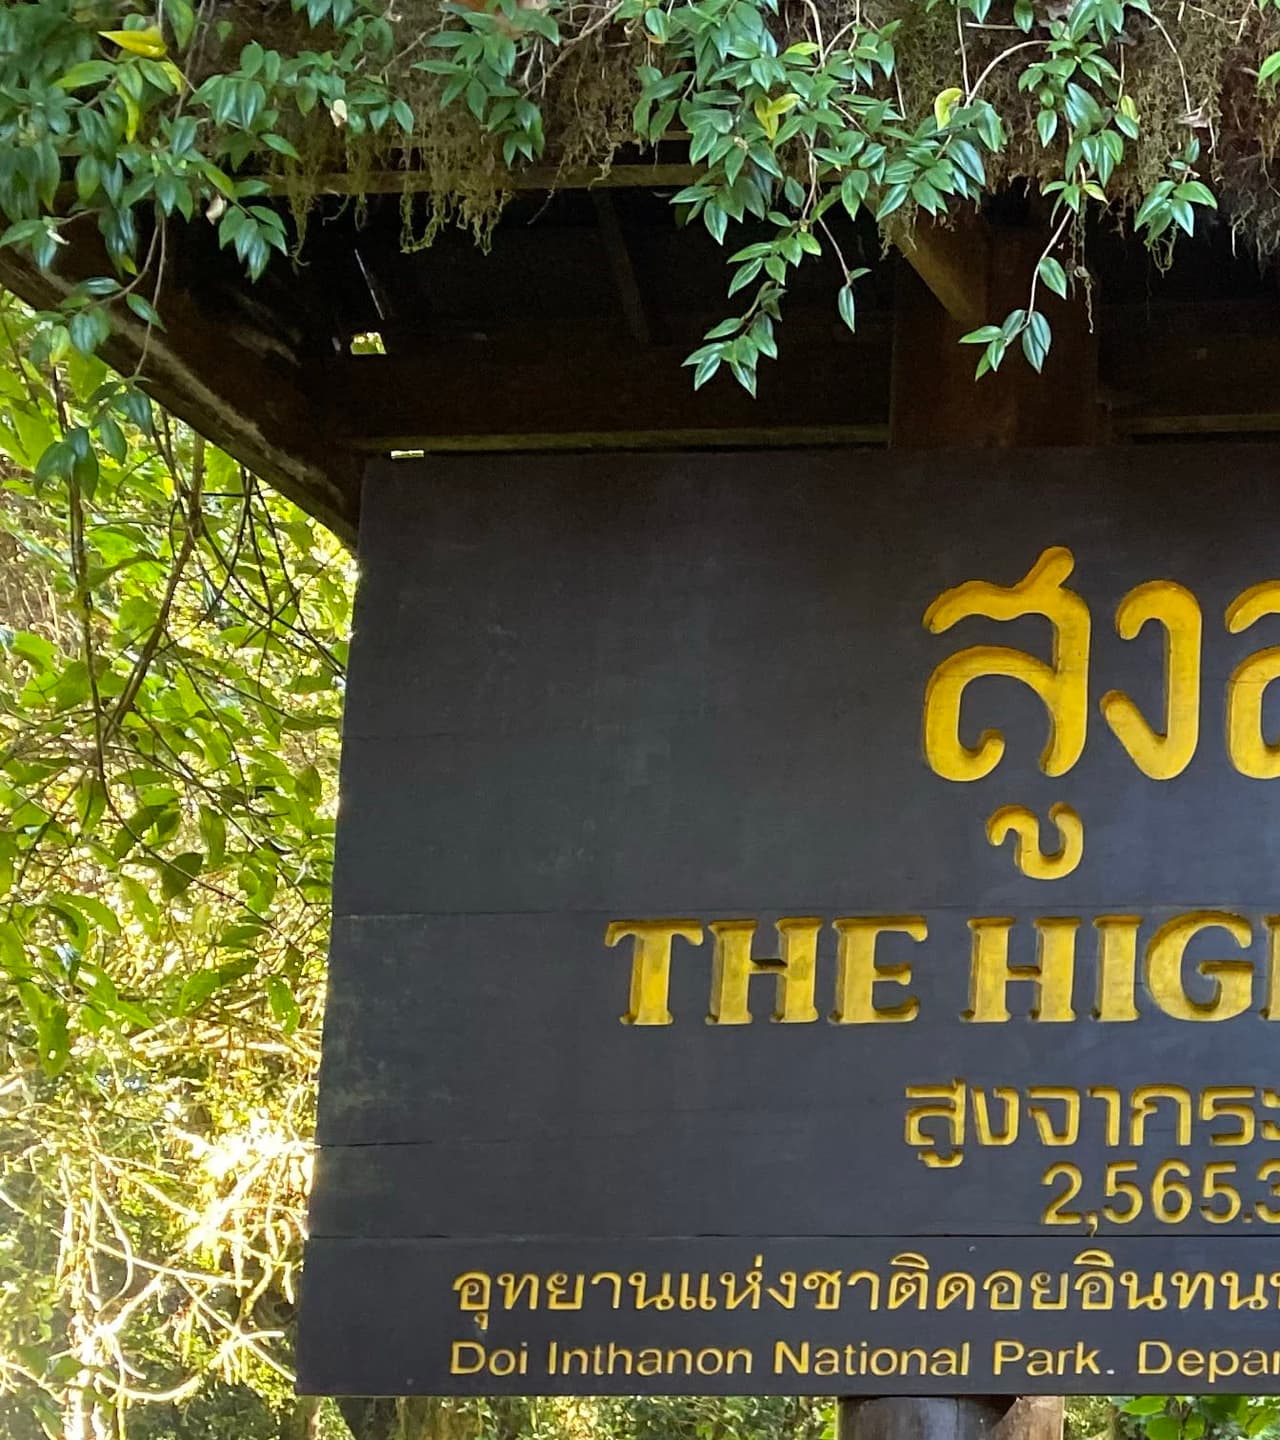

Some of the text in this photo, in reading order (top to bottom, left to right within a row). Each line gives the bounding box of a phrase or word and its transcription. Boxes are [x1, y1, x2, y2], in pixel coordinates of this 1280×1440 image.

[602, 914, 929, 1026] THE
[449, 1341, 528, 1377] Doi
[547, 1341, 753, 1377] Inthanon
[773, 1340, 971, 1377] National
